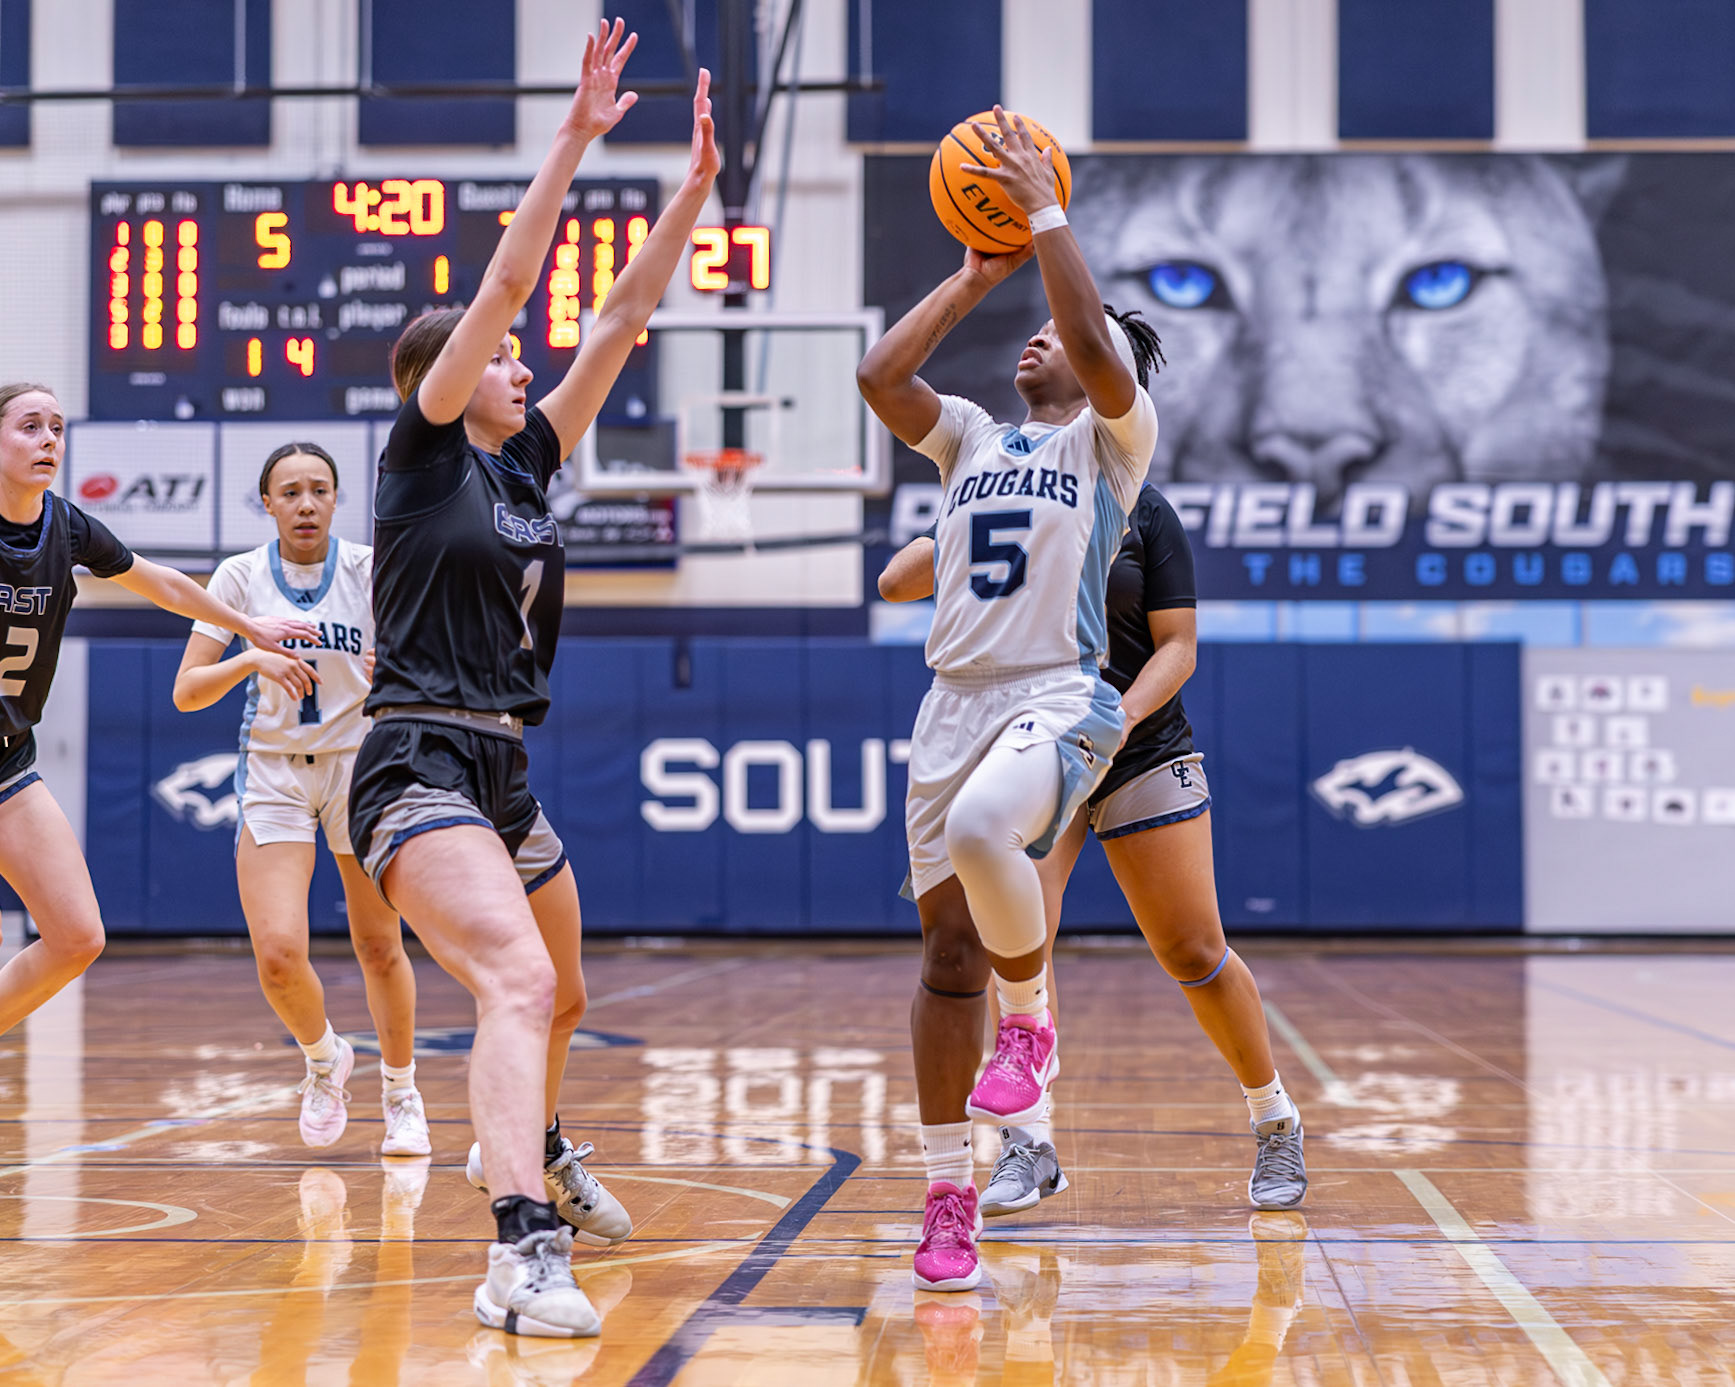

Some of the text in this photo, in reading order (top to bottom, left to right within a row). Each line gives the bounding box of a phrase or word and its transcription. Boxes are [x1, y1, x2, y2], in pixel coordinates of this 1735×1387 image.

[333, 179, 445, 236] 4:20
[961, 183, 1014, 228] EVO
[255, 212, 291, 269] 5
[691, 226, 771, 290] 27
[434, 255, 450, 294] 1
[248, 337, 263, 378] 1
[286, 337, 315, 377] 4
[121, 473, 206, 502] ATI
[946, 468, 1078, 517] COUGARS
[1426, 481, 1735, 548] SOUTH
[969, 508, 1034, 601] 5
[1243, 552, 1735, 587] THE COUGARS
[0, 583, 53, 616] AST
[0, 626, 40, 697] 2
